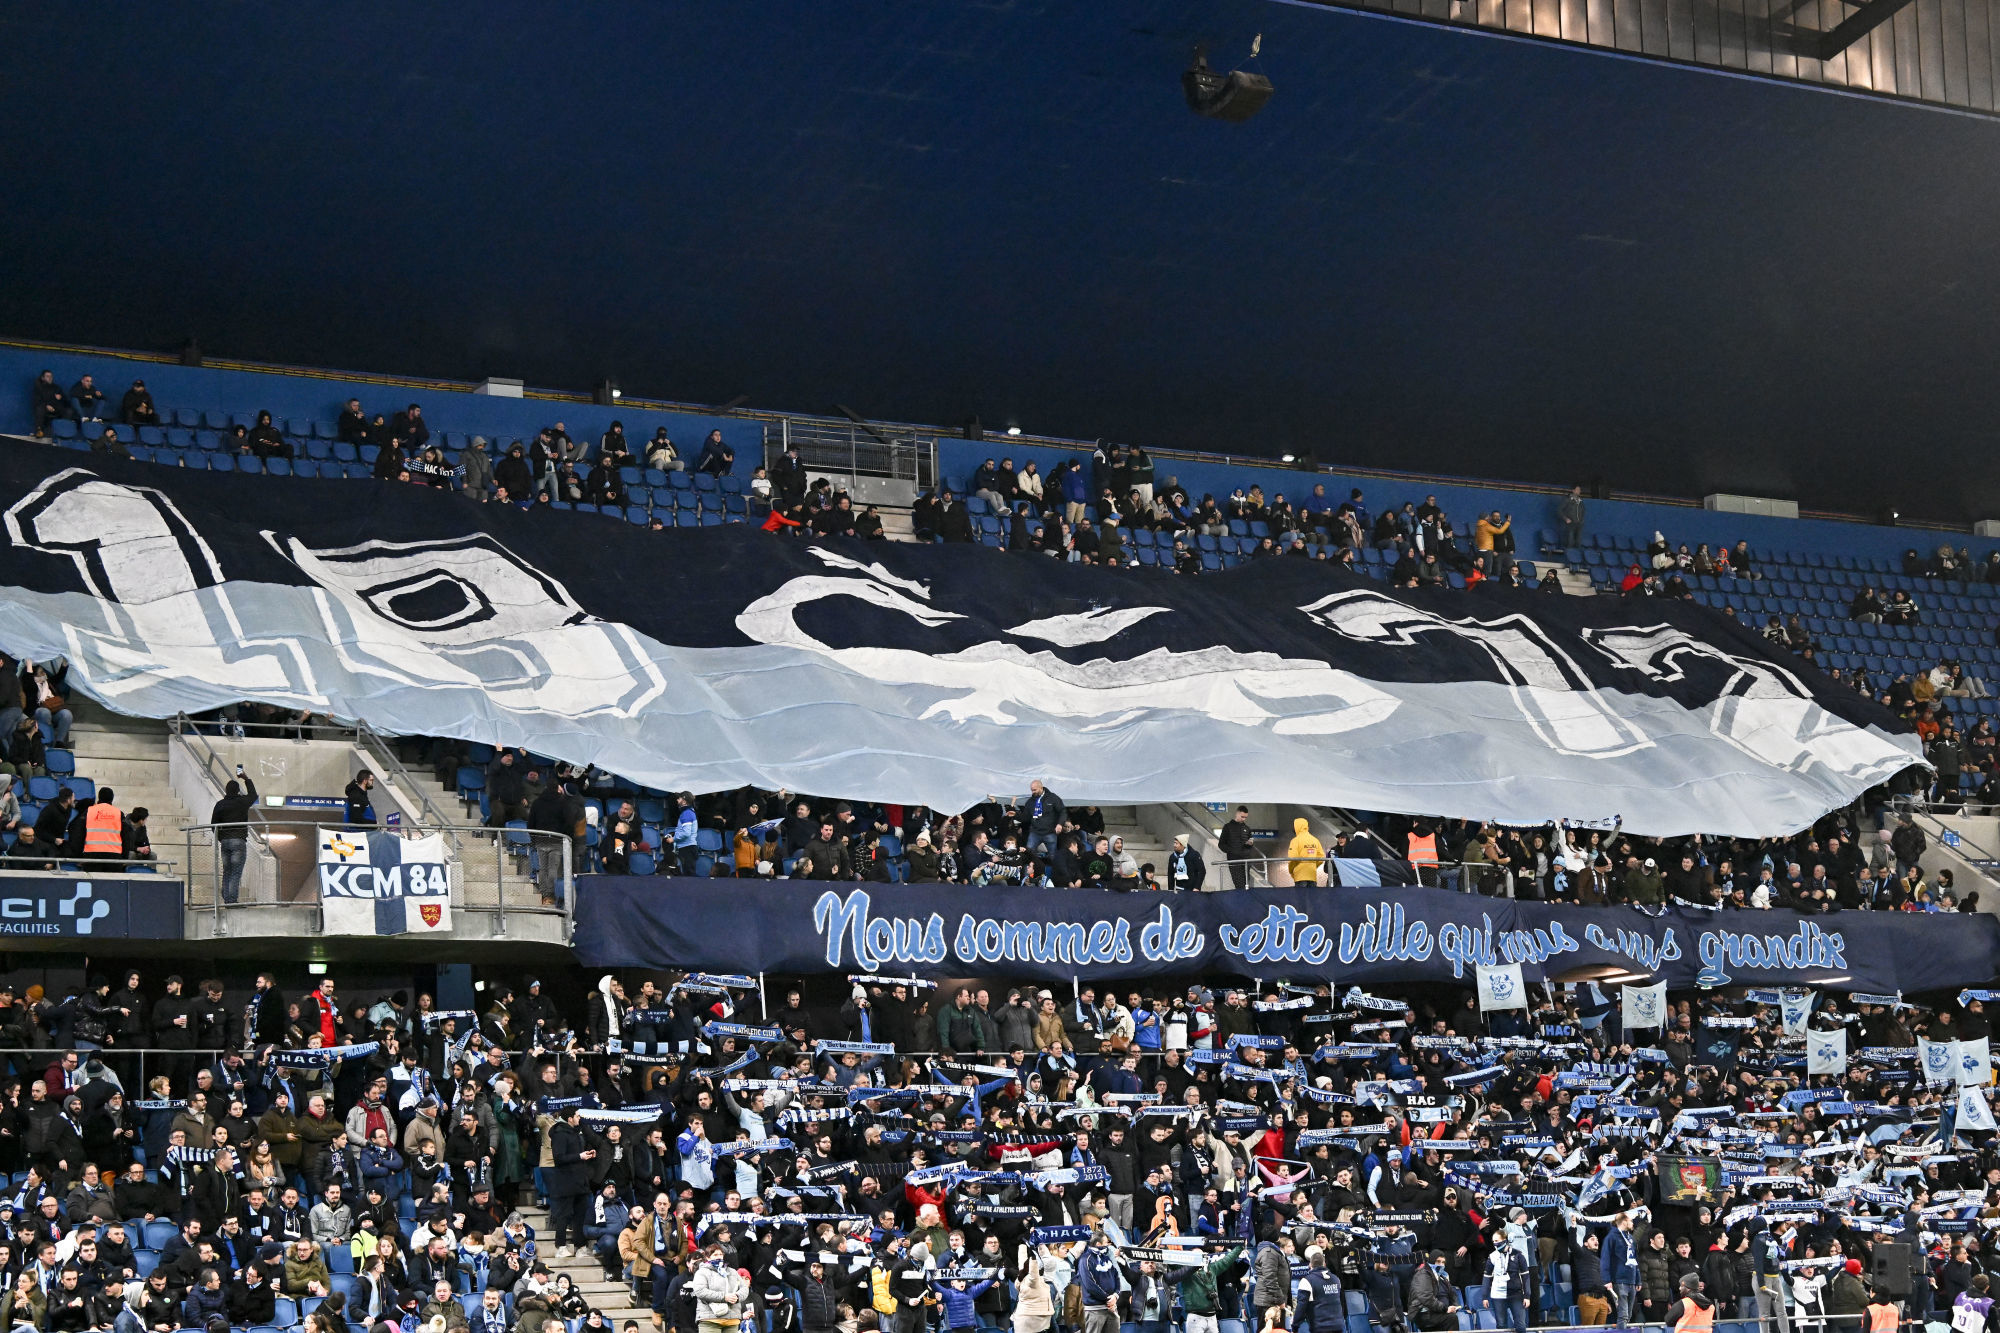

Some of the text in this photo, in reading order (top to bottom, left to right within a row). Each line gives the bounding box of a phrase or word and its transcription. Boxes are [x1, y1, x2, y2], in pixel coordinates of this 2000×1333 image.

[424, 463, 438, 475] HAC
[320, 864, 446, 898] KCM 84
[0, 923, 61, 934] FACILITIES
[813, 888, 945, 971] Nous
[954, 912, 1133, 964] sommes
[1140, 903, 1204, 962] de
[1218, 903, 1332, 965] cette
[1337, 901, 1434, 964] ville
[1438, 912, 1497, 979] qui
[1498, 920, 1580, 965] nous
[1696, 919, 1848, 987] grandir
[738, 1025, 761, 1036] ATHLETIC
[762, 1027, 777, 1037] CLUB
[1545, 1024, 1571, 1036] HAC
[1239, 1036, 1279, 1046] ALLEZ LE HAC
[346, 1042, 379, 1058] MARINE
[1191, 1051, 1232, 1060] ALLEZ LE HAC
[1791, 1091, 1812, 1100] ALLEZ
[1821, 1089, 1835, 1098] HAC
[547, 1096, 582, 1104] PASSIONNEMENT
[1407, 1095, 1436, 1106] HAC
[620, 1103, 661, 1111] PASSIONNEMENT
[721, 1142, 741, 1151] HAVRE
[766, 1138, 780, 1147] CLUB
[1512, 1136, 1539, 1145] HAVRE
[1539, 1135, 1553, 1143] AC
[1082, 1166, 1102, 1174] 1872
[1454, 1162, 1470, 1170] CIEL
[1083, 1173, 1103, 1181] 2012
[1493, 1194, 1515, 1205] CIEL
[1050, 1228, 1080, 1238] HAC
[1131, 1250, 1148, 1260] FIERS
[940, 1269, 961, 1278] HAC
